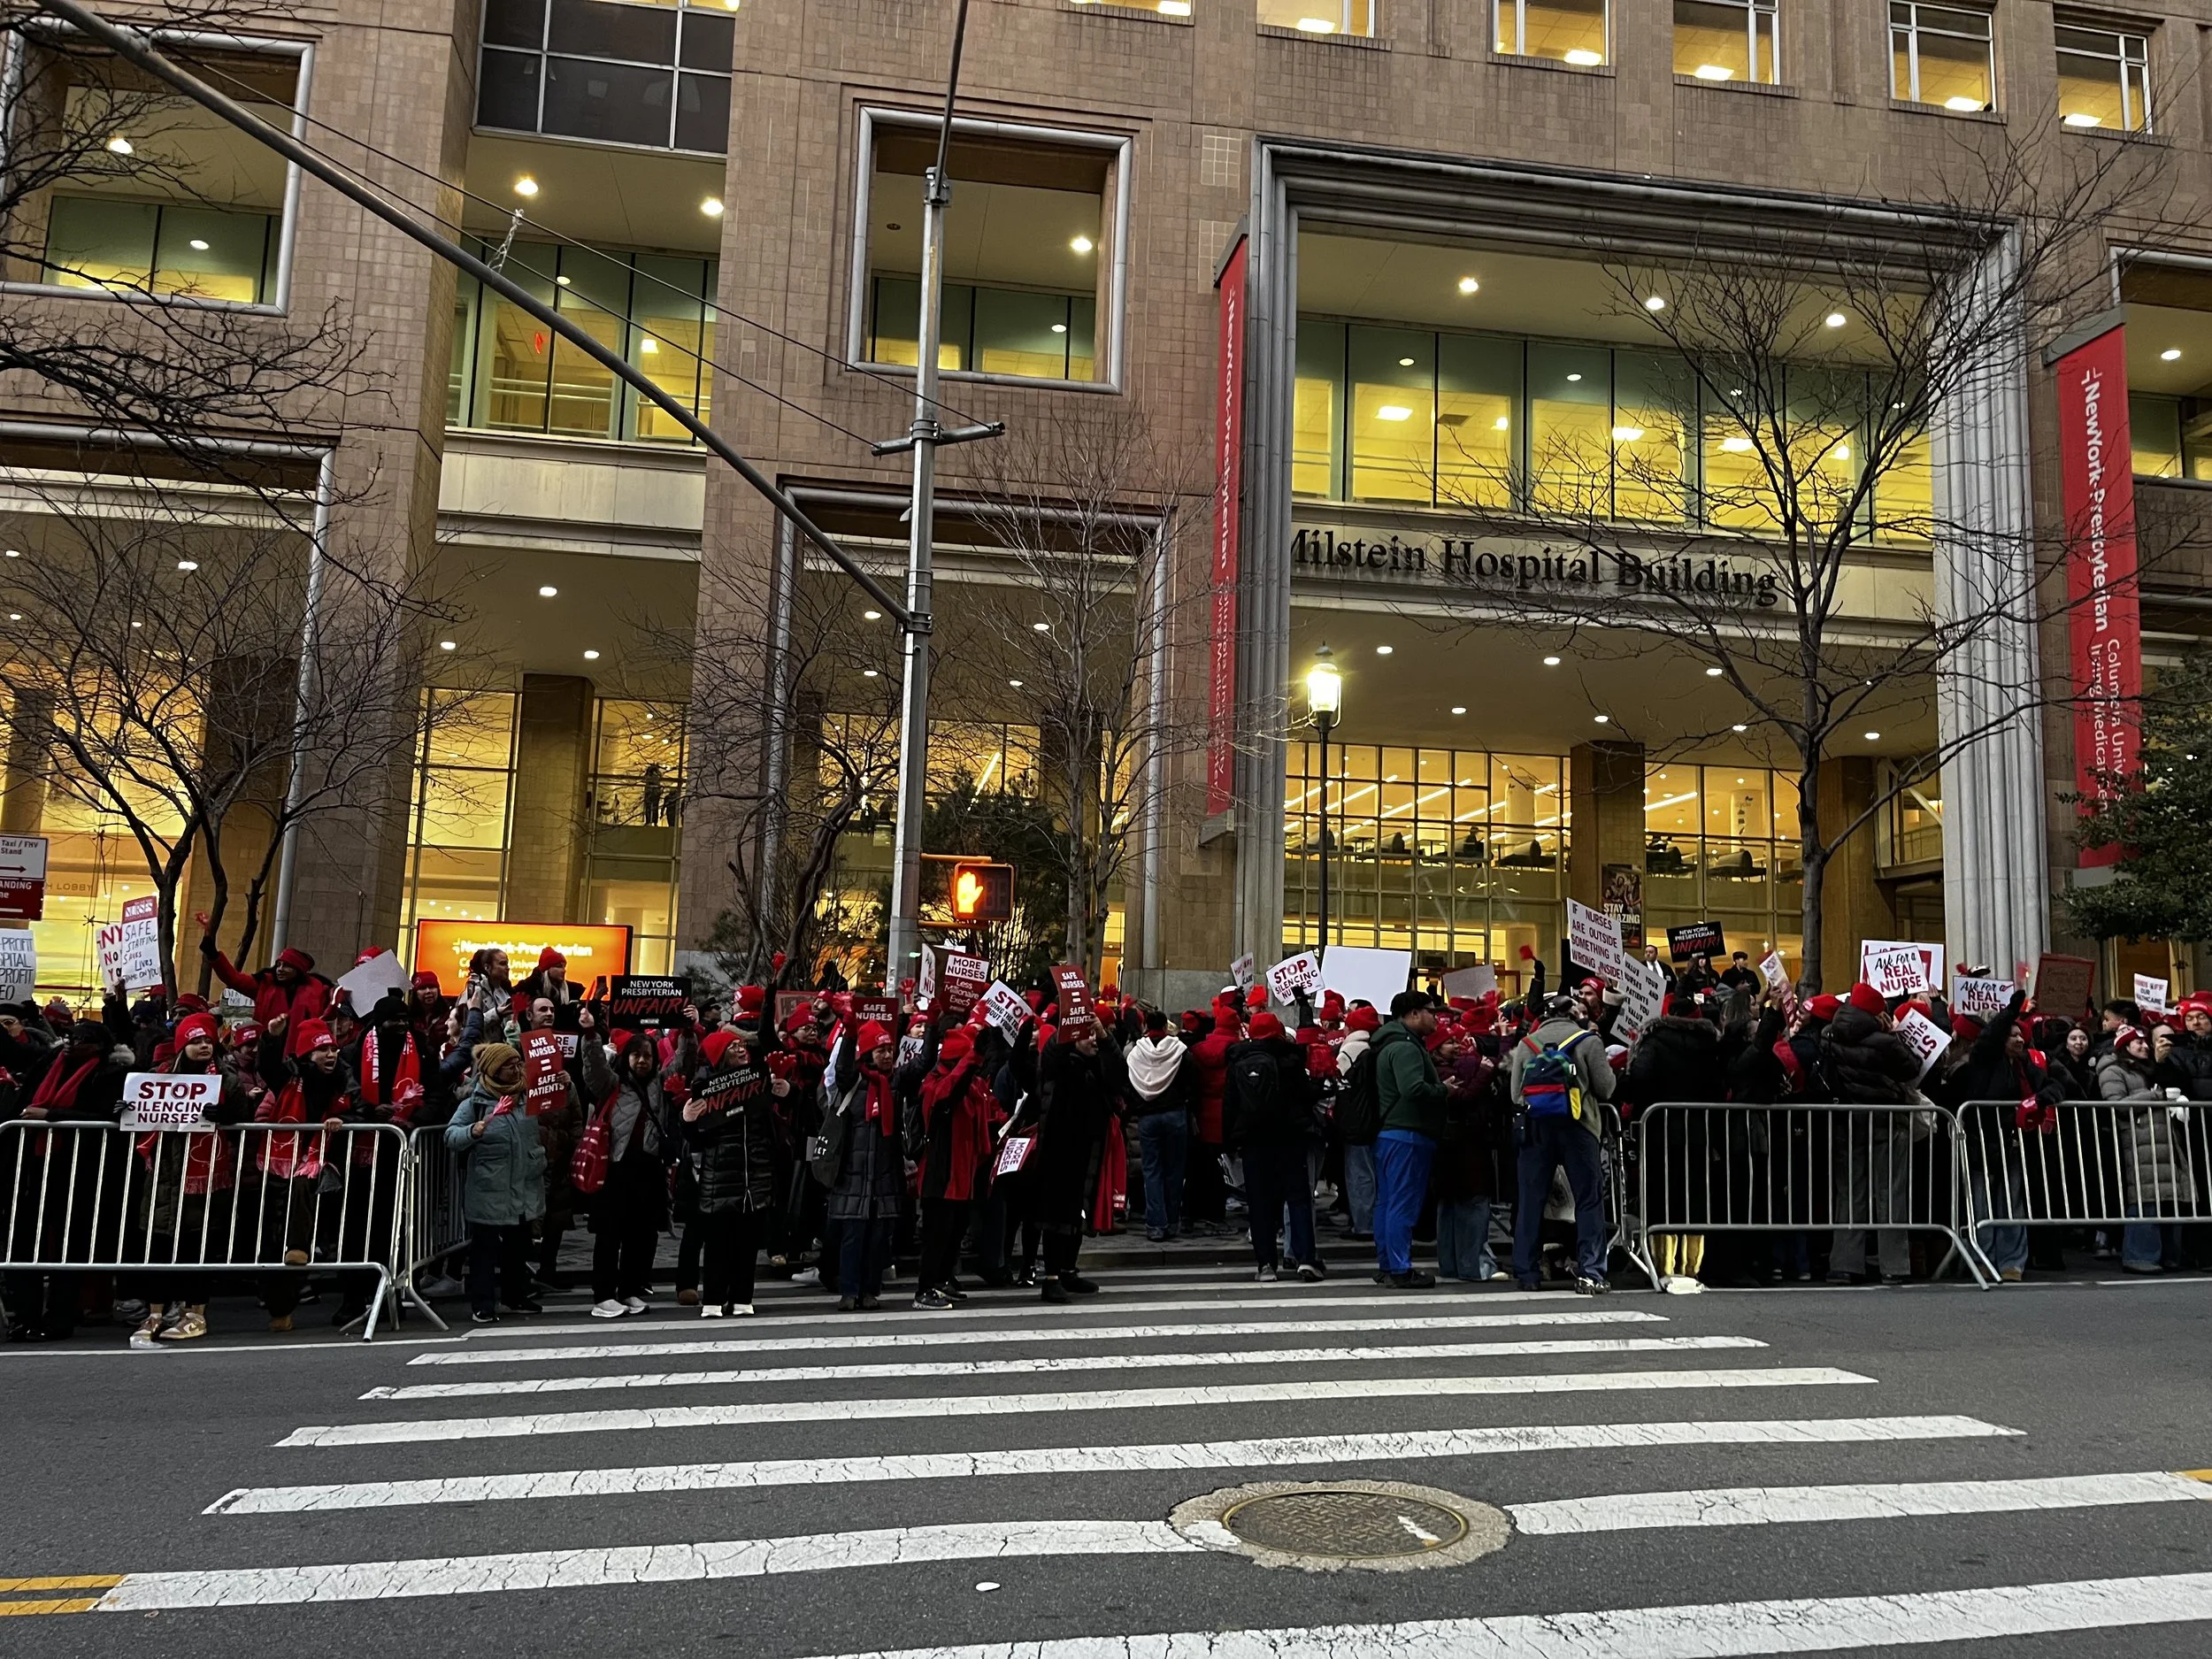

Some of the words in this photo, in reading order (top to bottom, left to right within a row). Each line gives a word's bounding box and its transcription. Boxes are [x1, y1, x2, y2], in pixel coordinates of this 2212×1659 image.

[1441, 539, 1602, 589] Hospital
[1615, 552, 1778, 607] Building
[1603, 903, 1624, 913] STAY
[1571, 903, 1578, 914] IF
[1585, 910, 1612, 930] NURSES
[1605, 913, 1640, 924] MAZING
[125, 921, 151, 942] SAFE
[1571, 919, 1585, 934] ARE
[1588, 928, 1617, 948] OUTSIDE
[1571, 934, 1609, 960] SOMETHING
[1614, 953, 1621, 964] IS
[1672, 934, 1721, 953] UNFAIR!
[953, 956, 982, 970] MORE
[1571, 949, 1596, 968] WRONG
[1597, 961, 1624, 980] INSIDE!
[1875, 954, 1893, 971] Ask
[1911, 952, 1916, 961] a
[947, 965, 986, 980] NURSES
[1274, 959, 1308, 984] STOP
[1883, 963, 1916, 979] REAL
[956, 978, 973, 989] Less
[1060, 979, 1085, 989] NURSES
[1275, 970, 1318, 995] SILENCING
[1645, 976, 1659, 990] YOUR
[1879, 975, 1922, 993] NURSE
[1961, 980, 1979, 992] Ask
[1625, 985, 1648, 1006] PATIENTS
[1648, 989, 1659, 1002] AND
[1968, 990, 2001, 1002] REAL
[864, 1003, 886, 1012] SAFE
[1069, 1007, 1086, 1016] SAFE
[1640, 1002, 1649, 1016] YOU
[856, 1012, 893, 1021] NURSES
[531, 1037, 548, 1048] SAFE
[1917, 1034, 1937, 1060] ST
[528, 1045, 557, 1058] NURSES
[538, 1073, 556, 1086] SAFE
[702, 1071, 760, 1096] PRESBYTERIAN
[709, 1074, 728, 1087] NEW
[729, 1067, 751, 1079] YORK
[138, 1081, 207, 1100] STOP
[528, 1082, 565, 1098] PATIENTS
[708, 1076, 768, 1113] NFAIR!
[127, 1101, 212, 1113] SILENCIN
[137, 1113, 199, 1124] NURSES
[1000, 1139, 1017, 1172] NURSES
[1010, 1141, 1025, 1164] MORE
